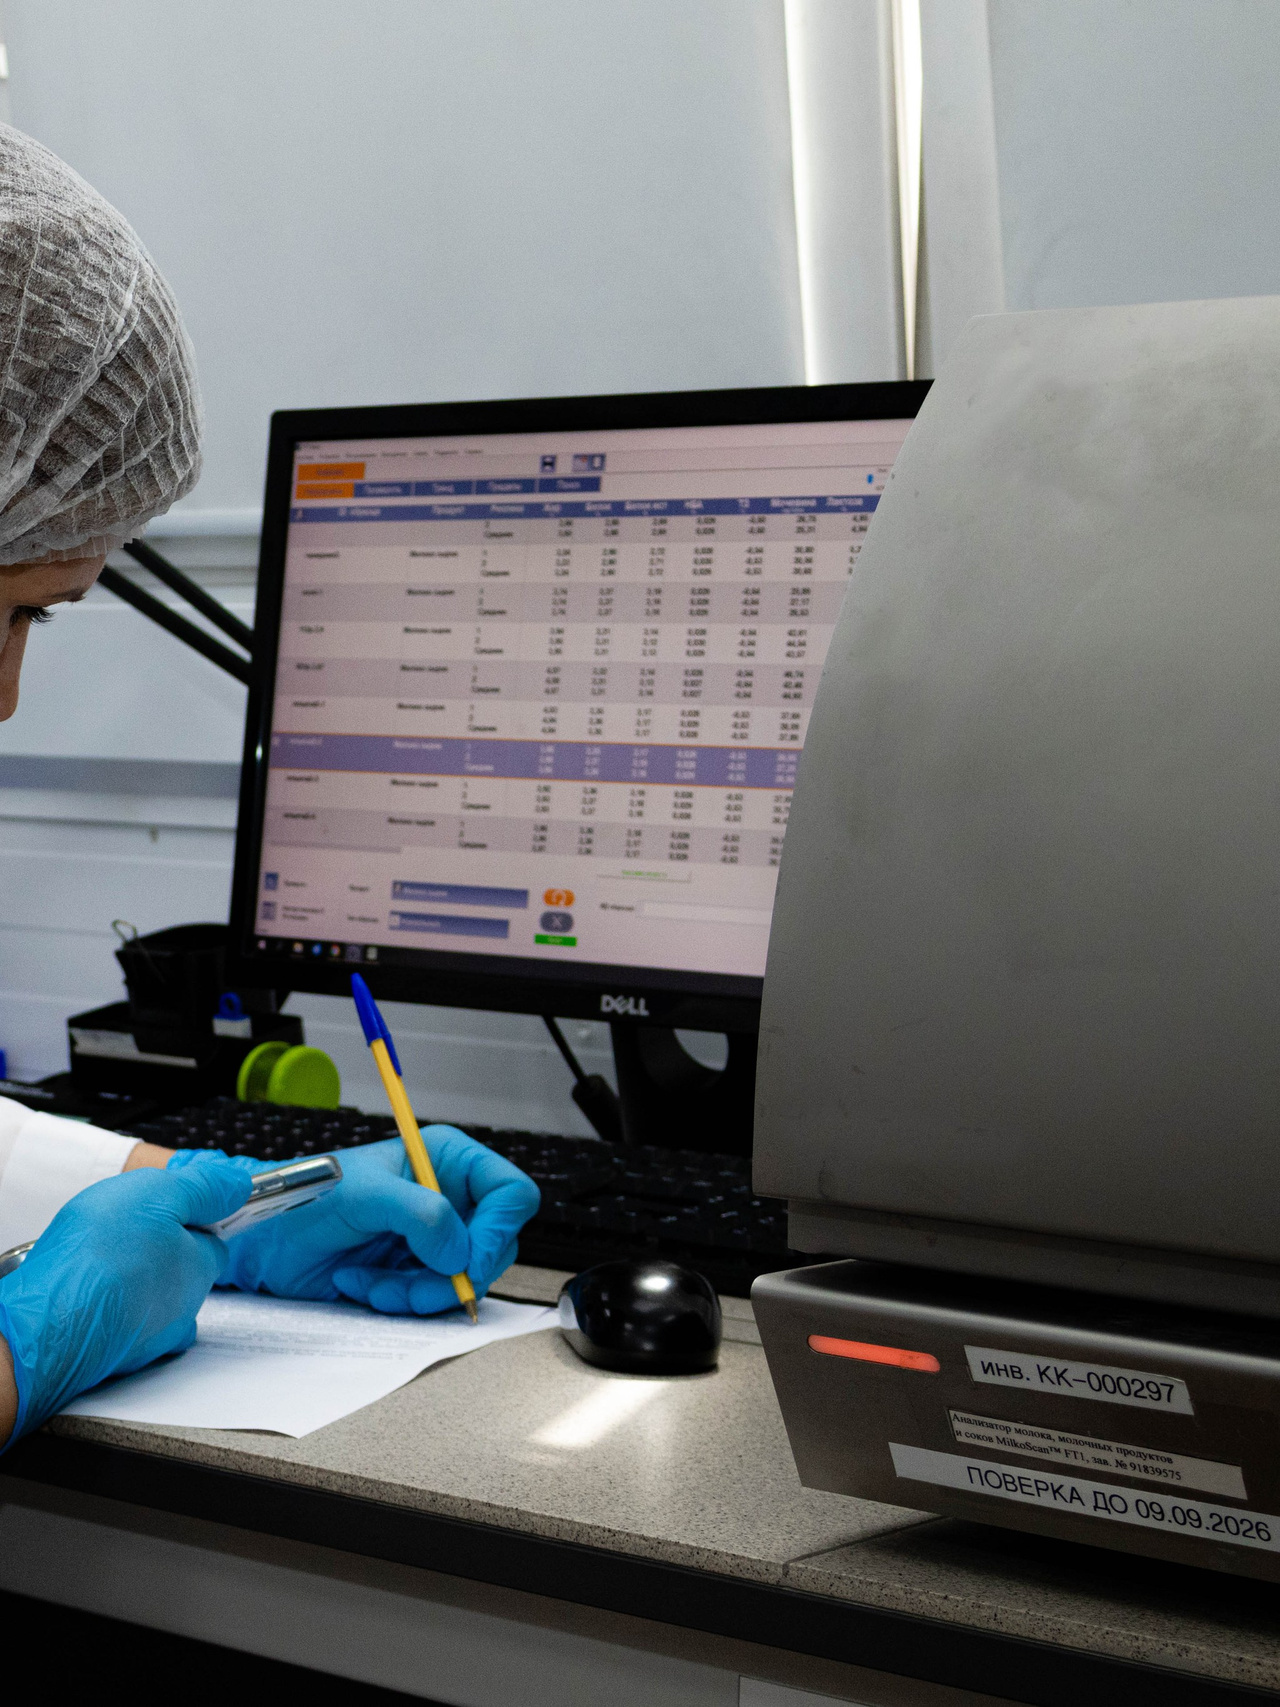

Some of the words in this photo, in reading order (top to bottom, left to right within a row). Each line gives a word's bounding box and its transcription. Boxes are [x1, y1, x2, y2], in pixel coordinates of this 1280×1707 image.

[600, 994, 650, 1016] DELL
[952, 1413, 1012, 1434] Анализатор
[1014, 1427, 1056, 1442] молока,
[1058, 1436, 1113, 1453] молочных
[1115, 1447, 1174, 1465] продуктов
[965, 1432, 994, 1443] соков
[1091, 1456, 1112, 1467] зав.
[1130, 1462, 1182, 1481] 91839575
[967, 1466, 1086, 1507] ПОВЕРКА
[1092, 1490, 1128, 1515] ДО
[1135, 1498, 1273, 1542] 09.09.2026
